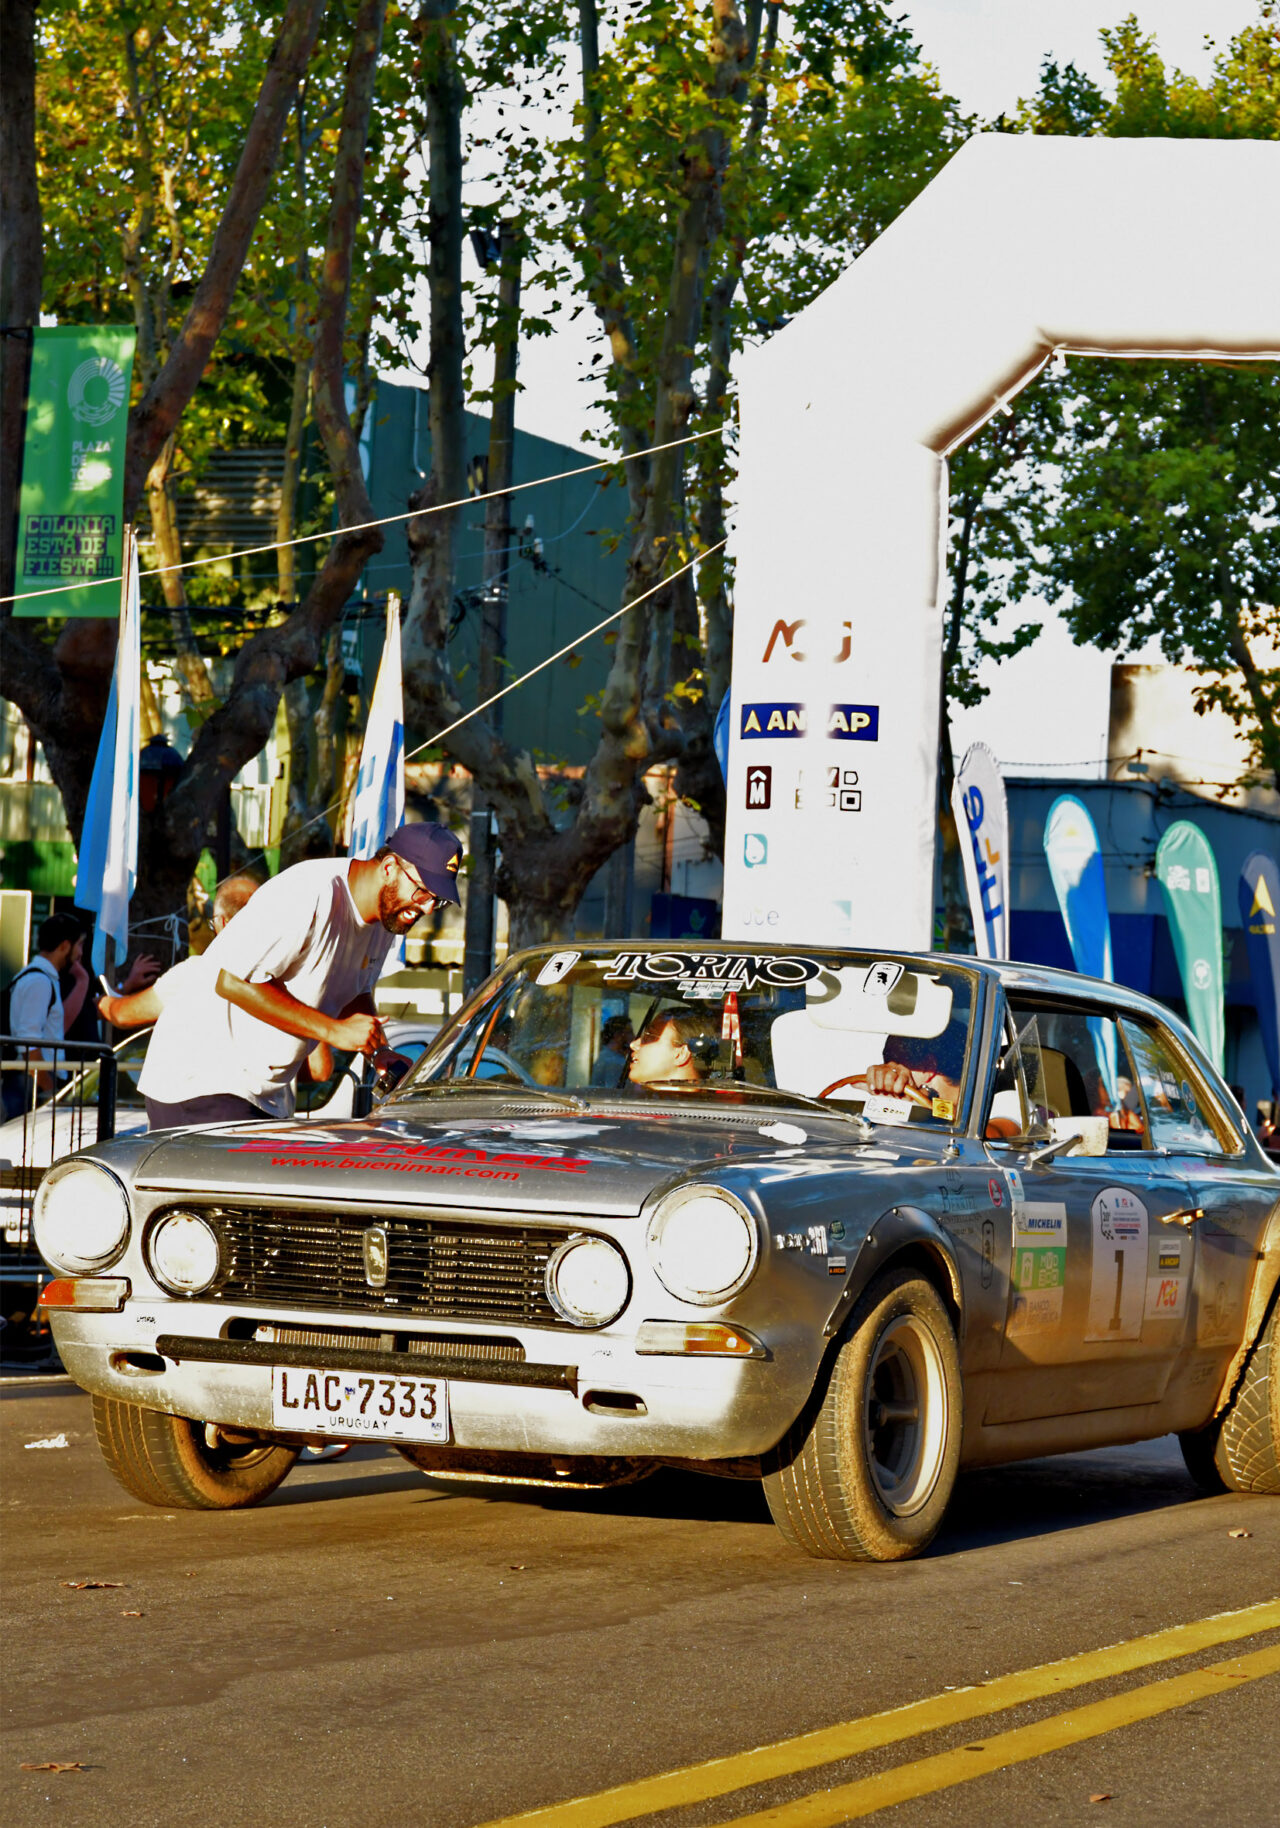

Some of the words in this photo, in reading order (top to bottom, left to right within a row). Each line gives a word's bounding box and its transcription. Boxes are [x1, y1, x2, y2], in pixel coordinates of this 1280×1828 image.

[72, 441, 111, 452] PLAZA
[72, 455, 87, 466] DE
[27, 516, 114, 534] COLONIA
[80, 537, 105, 554] DE
[604, 953, 822, 987] TORINO
[238, 1140, 592, 1169] BUENIMAR
[271, 1155, 519, 1181] www.buenimar.com
[1028, 1218, 1062, 1229] MICHELIN
[1108, 1250, 1124, 1330] 1
[282, 1372, 341, 1412] LAC
[358, 1378, 437, 1420] 7333
[329, 1416, 388, 1430] URUGUAY
